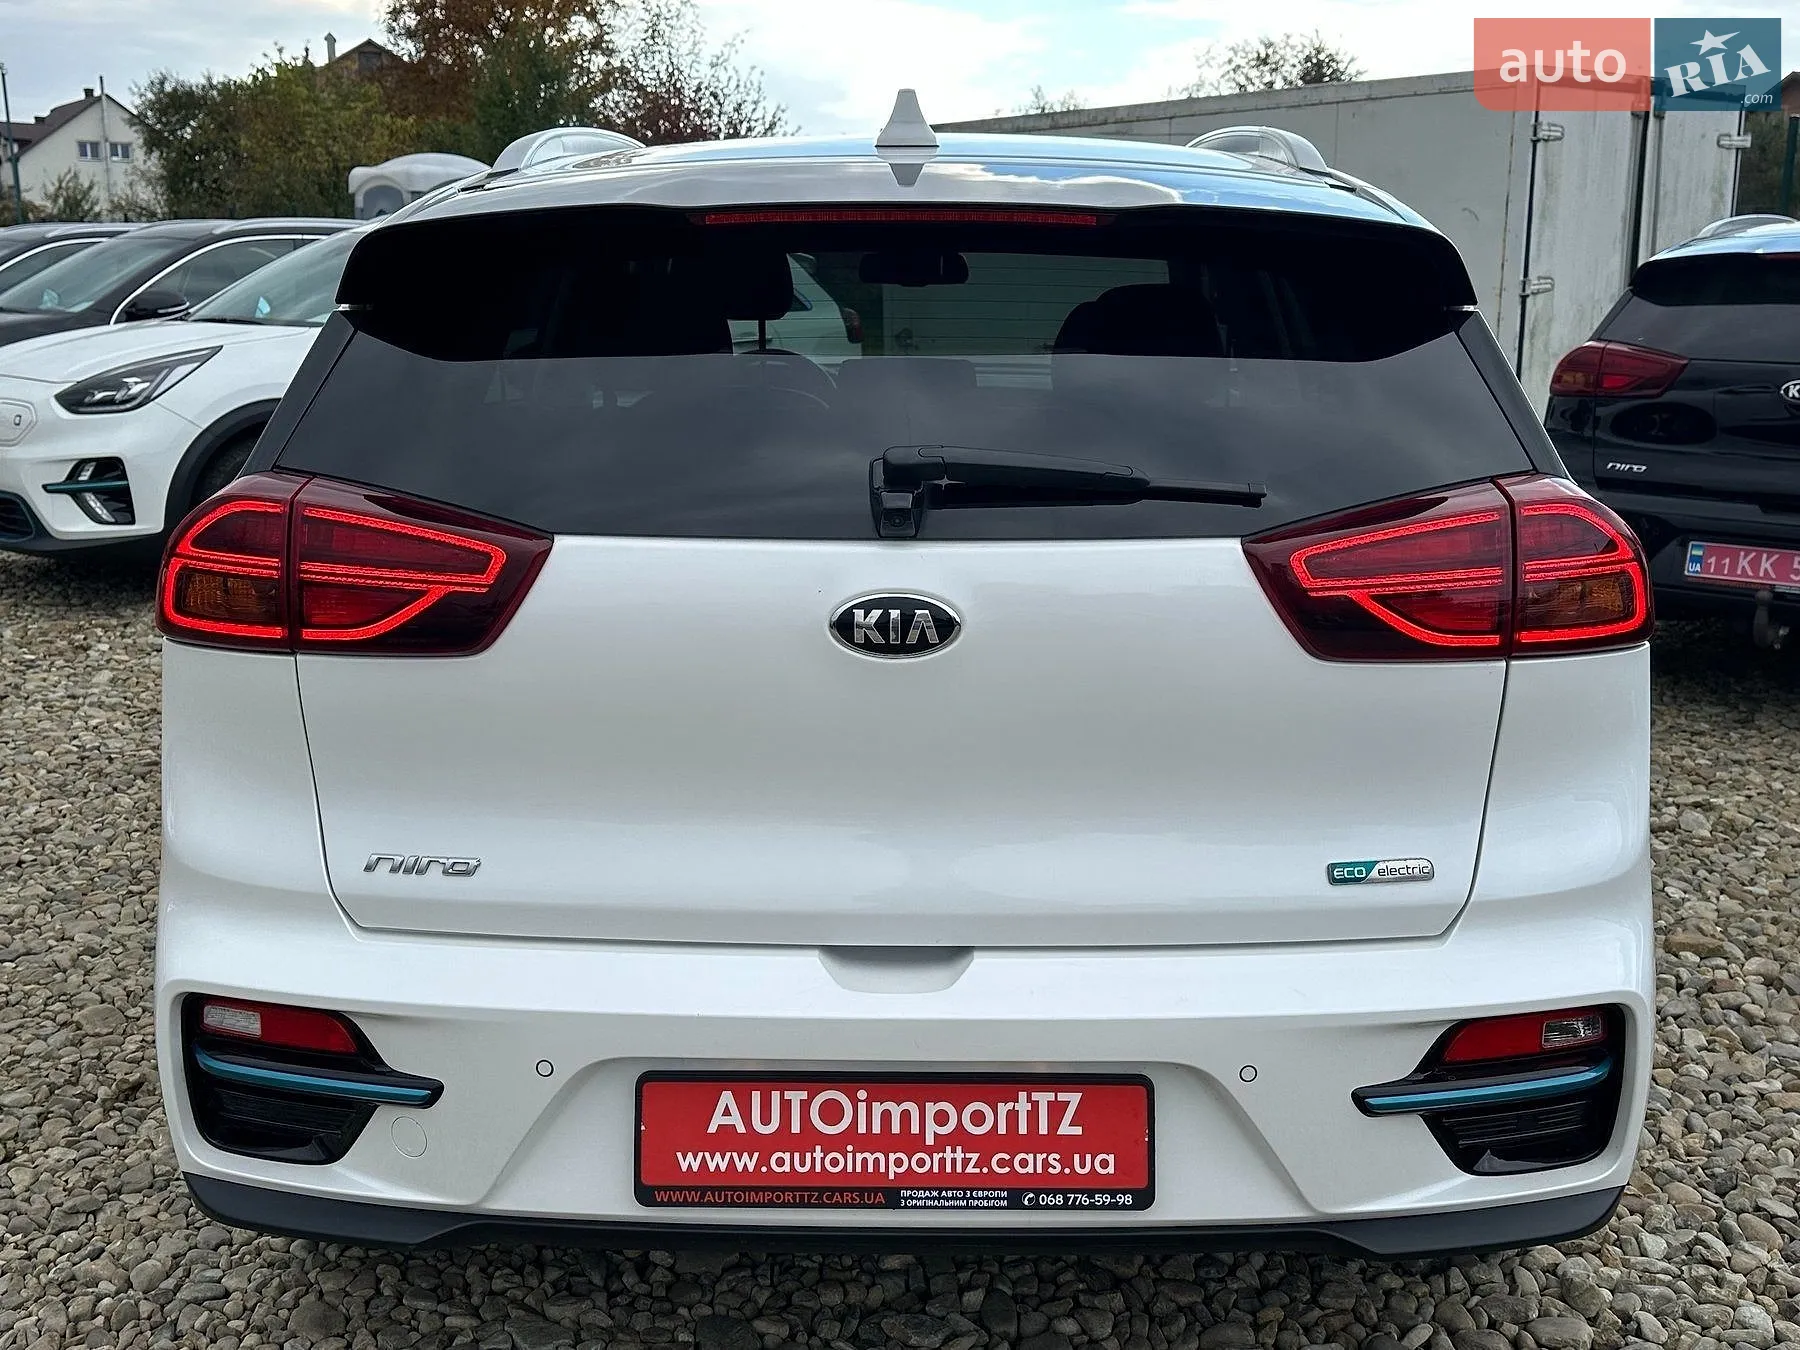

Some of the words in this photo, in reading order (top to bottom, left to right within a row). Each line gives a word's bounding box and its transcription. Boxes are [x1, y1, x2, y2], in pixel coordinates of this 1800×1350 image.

[1688, 562, 1701, 573] UA
[852, 609, 940, 644] KIA
[363, 853, 481, 878] niro
[1333, 866, 1366, 879] ECO
[1377, 864, 1430, 877] electric
[706, 1089, 1083, 1145] AUTOimportTZ
[676, 1145, 1116, 1180] www.autoimporttz.cars.ua
[654, 1190, 885, 1204] WWW.AUTOIMPORTTZ.CARS.UA
[900, 1190, 939, 1198] ПРОДАЖ
[940, 1190, 964, 1198] АВТО
[972, 1190, 1008, 1198] ЄВРОПИ
[1038, 1193, 1063, 1205] 068
[1067, 1193, 1133, 1206] 776-59-98
[906, 1199, 967, 1207] ОРИГІНАЛЬНИМ
[968, 1199, 1008, 1207] ПРОБІГОМ
